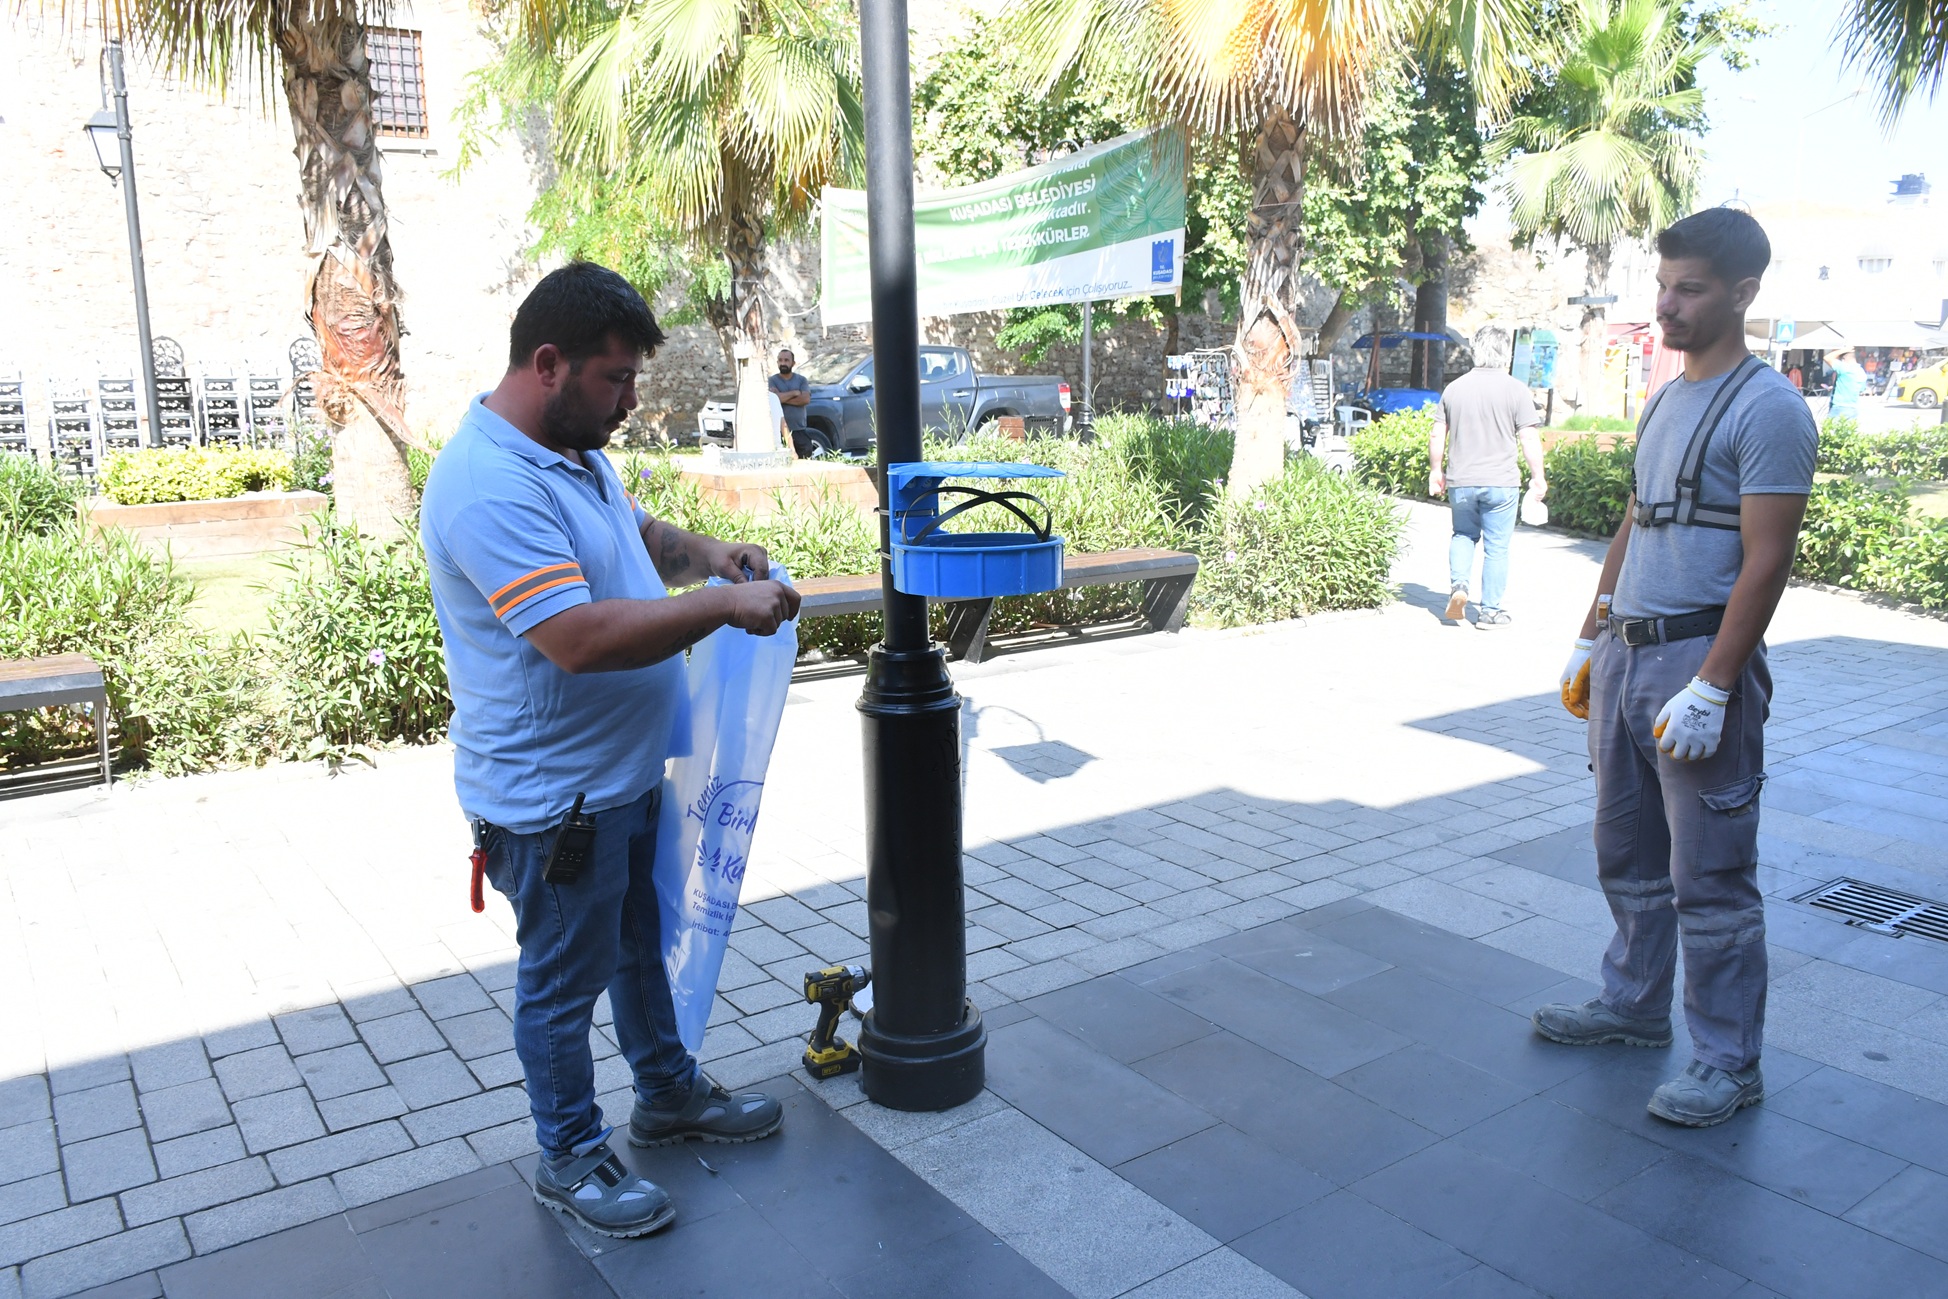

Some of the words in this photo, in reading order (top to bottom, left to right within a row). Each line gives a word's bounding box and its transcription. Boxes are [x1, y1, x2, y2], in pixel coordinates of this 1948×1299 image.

[949, 196, 1013, 223] KUŞADASI
[1015, 173, 1097, 209] BELEDİYESİ
[686, 774, 723, 823] Temiz
[717, 801, 758, 835] Birl
[721, 855, 745, 884] Ku
[692, 888, 731, 910] KUŞADASI
[692, 901, 724, 921] Temizlik
[691, 919, 720, 937] İrtibat:
